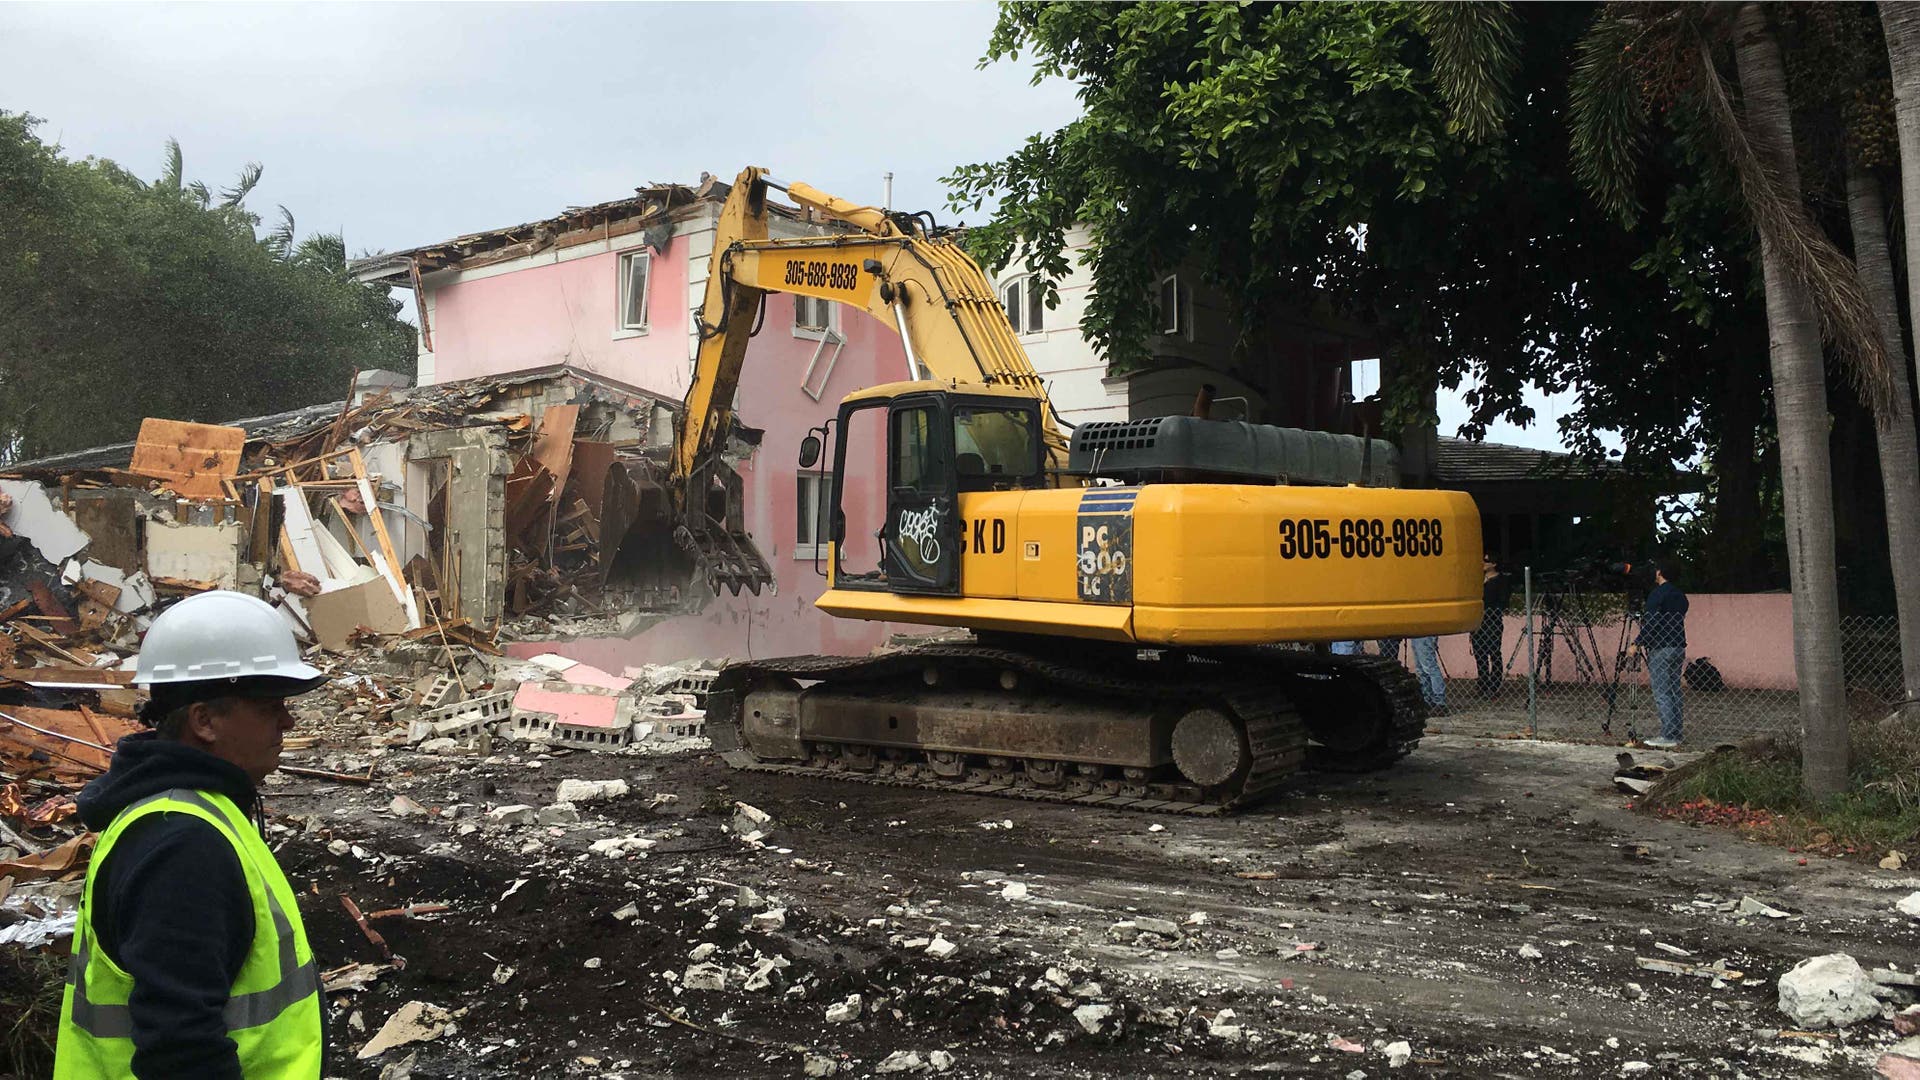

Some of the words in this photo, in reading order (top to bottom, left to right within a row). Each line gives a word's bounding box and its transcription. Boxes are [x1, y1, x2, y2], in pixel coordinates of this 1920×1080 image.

[785, 260, 858, 290] 305-688-9838
[1082, 525, 1108, 549] PC
[1279, 518, 1443, 560] 305-688-9838
[1081, 550, 1126, 576] 300
[1083, 576, 1101, 596] LC
